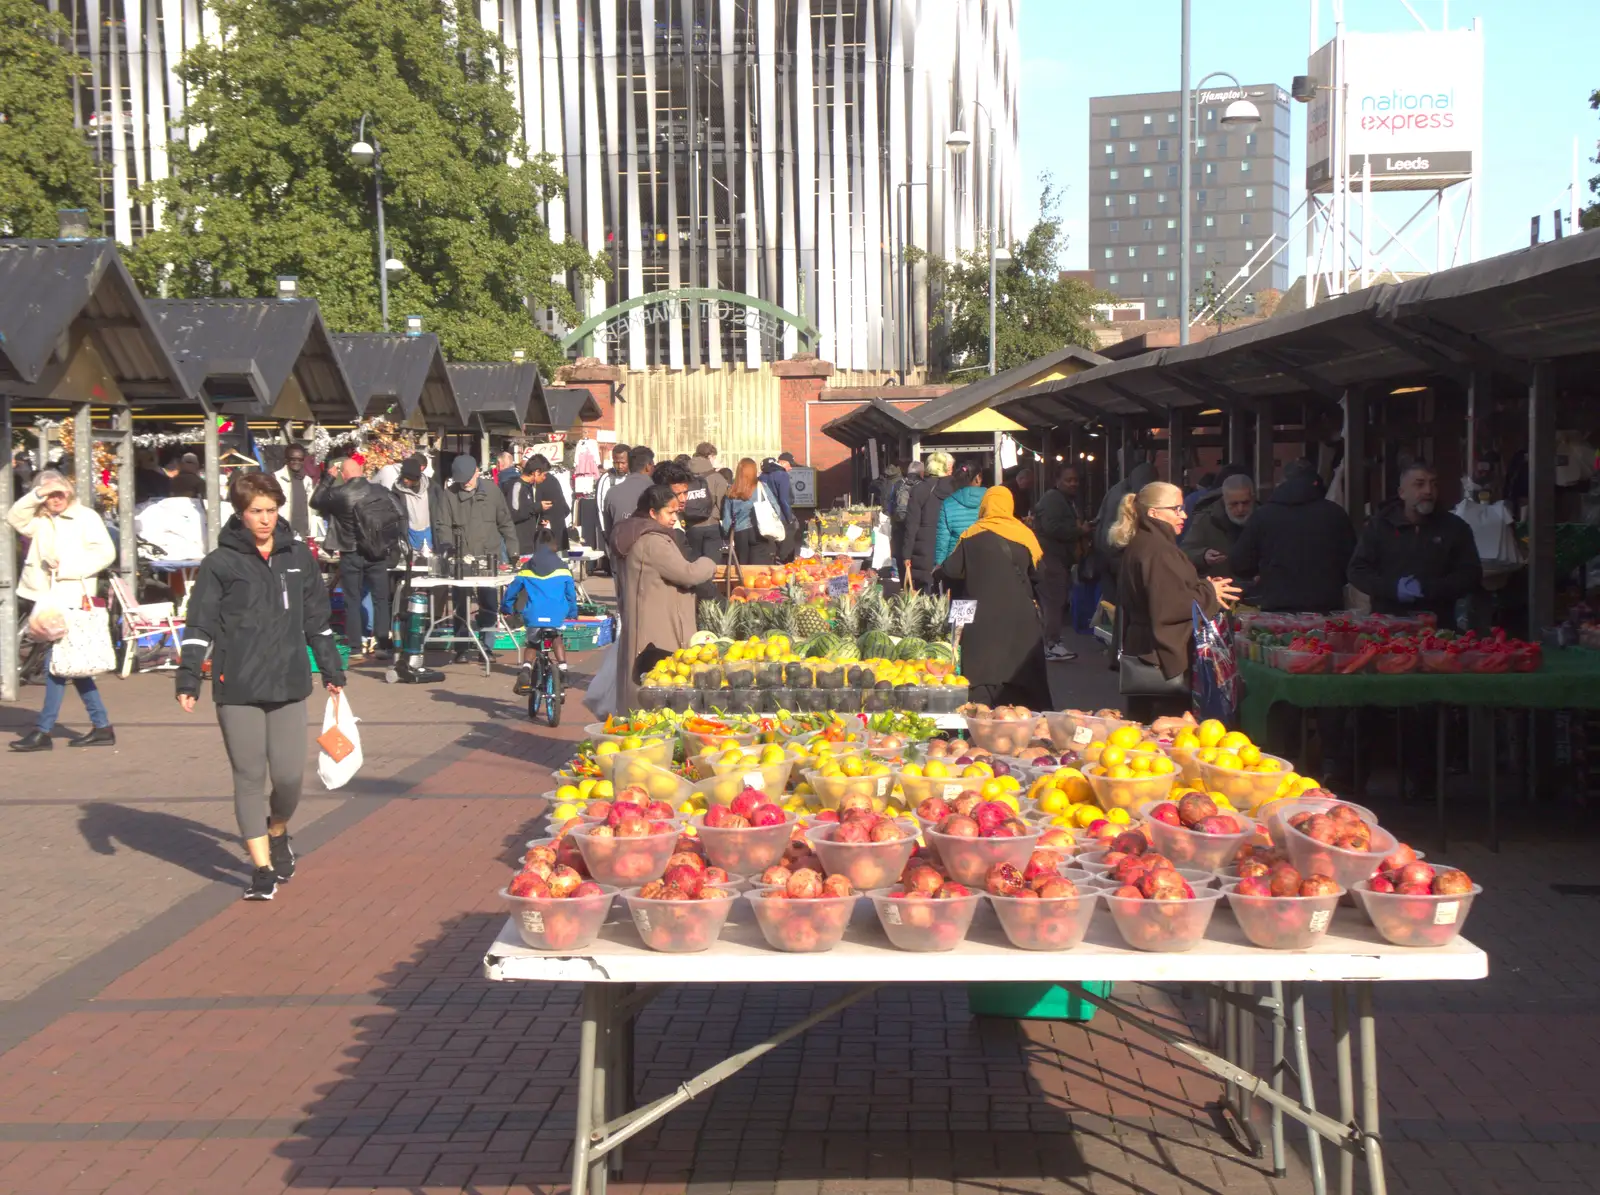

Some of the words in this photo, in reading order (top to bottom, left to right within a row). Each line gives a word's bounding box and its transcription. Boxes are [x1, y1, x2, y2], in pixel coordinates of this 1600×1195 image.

[1198, 89, 1247, 104] Hampton
[1361, 87, 1454, 111] national
[1361, 113, 1454, 135] express
[1386, 157, 1430, 171] Leeds
[610, 383, 626, 404] K
